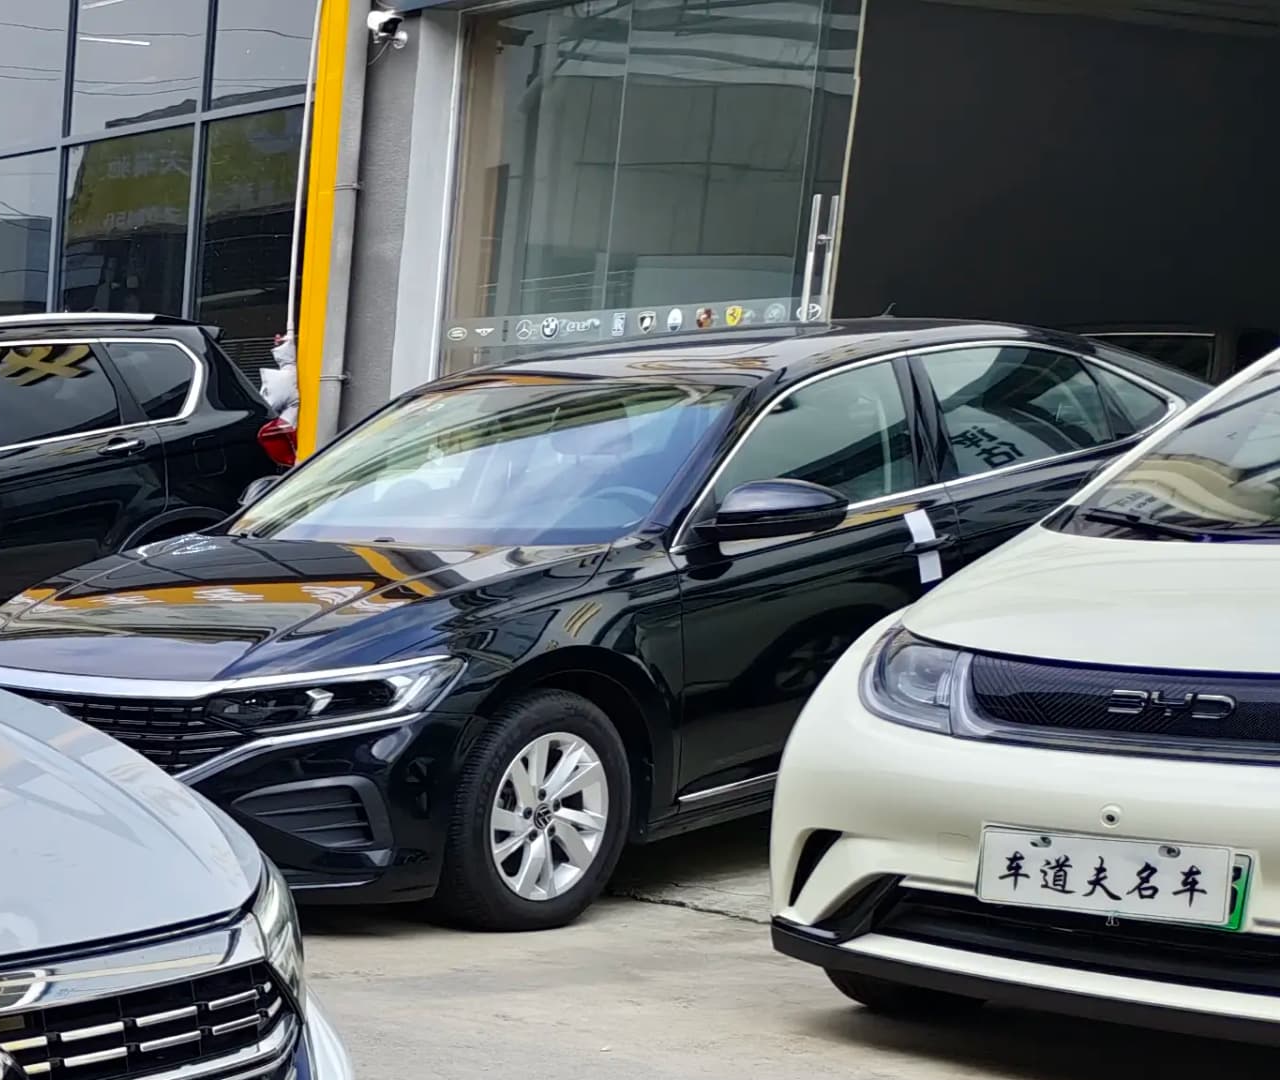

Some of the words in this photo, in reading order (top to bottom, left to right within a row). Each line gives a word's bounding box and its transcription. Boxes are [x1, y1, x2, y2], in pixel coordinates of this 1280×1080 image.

[1107, 689, 1237, 720] BYD
[997, 850, 1209, 907] 车道夫名车
